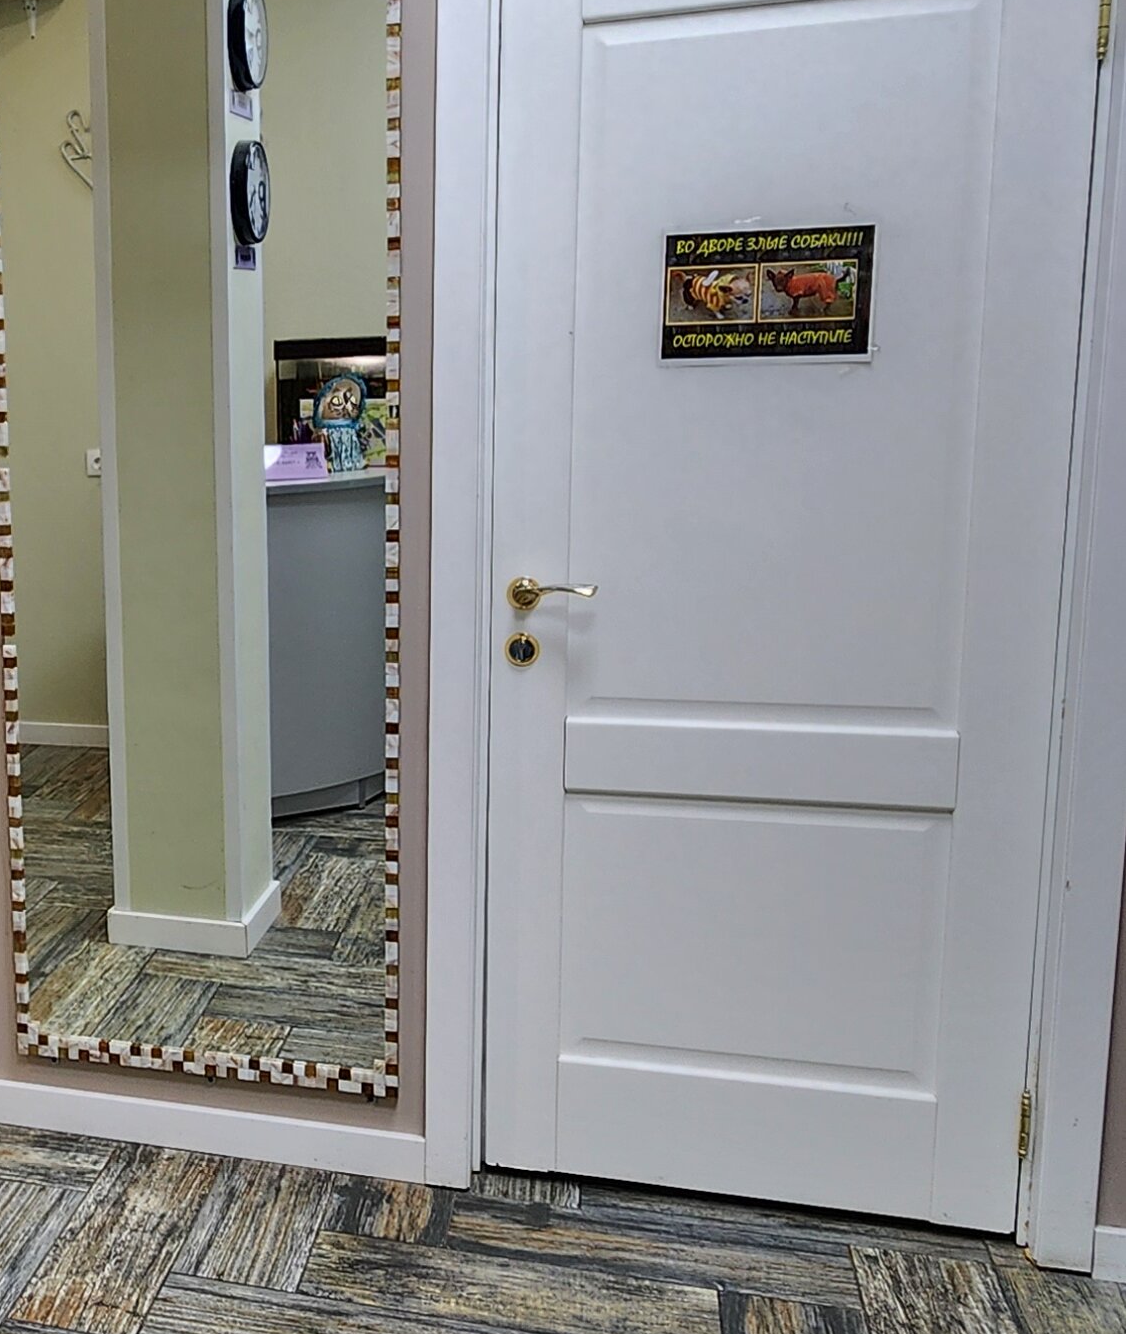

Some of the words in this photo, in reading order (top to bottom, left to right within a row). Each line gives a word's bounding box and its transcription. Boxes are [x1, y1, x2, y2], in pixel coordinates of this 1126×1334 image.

[676, 240, 695, 255] ВО
[697, 237, 743, 257] ДВОРЕ
[745, 234, 788, 251] ЗЛЫЕ
[790, 231, 863, 248] СОБАКИ!!!
[673, 331, 754, 348] ОСТОРОЖНО
[758, 331, 776, 345] НЕ
[779, 329, 853, 346] НАСТУПИТЕ
